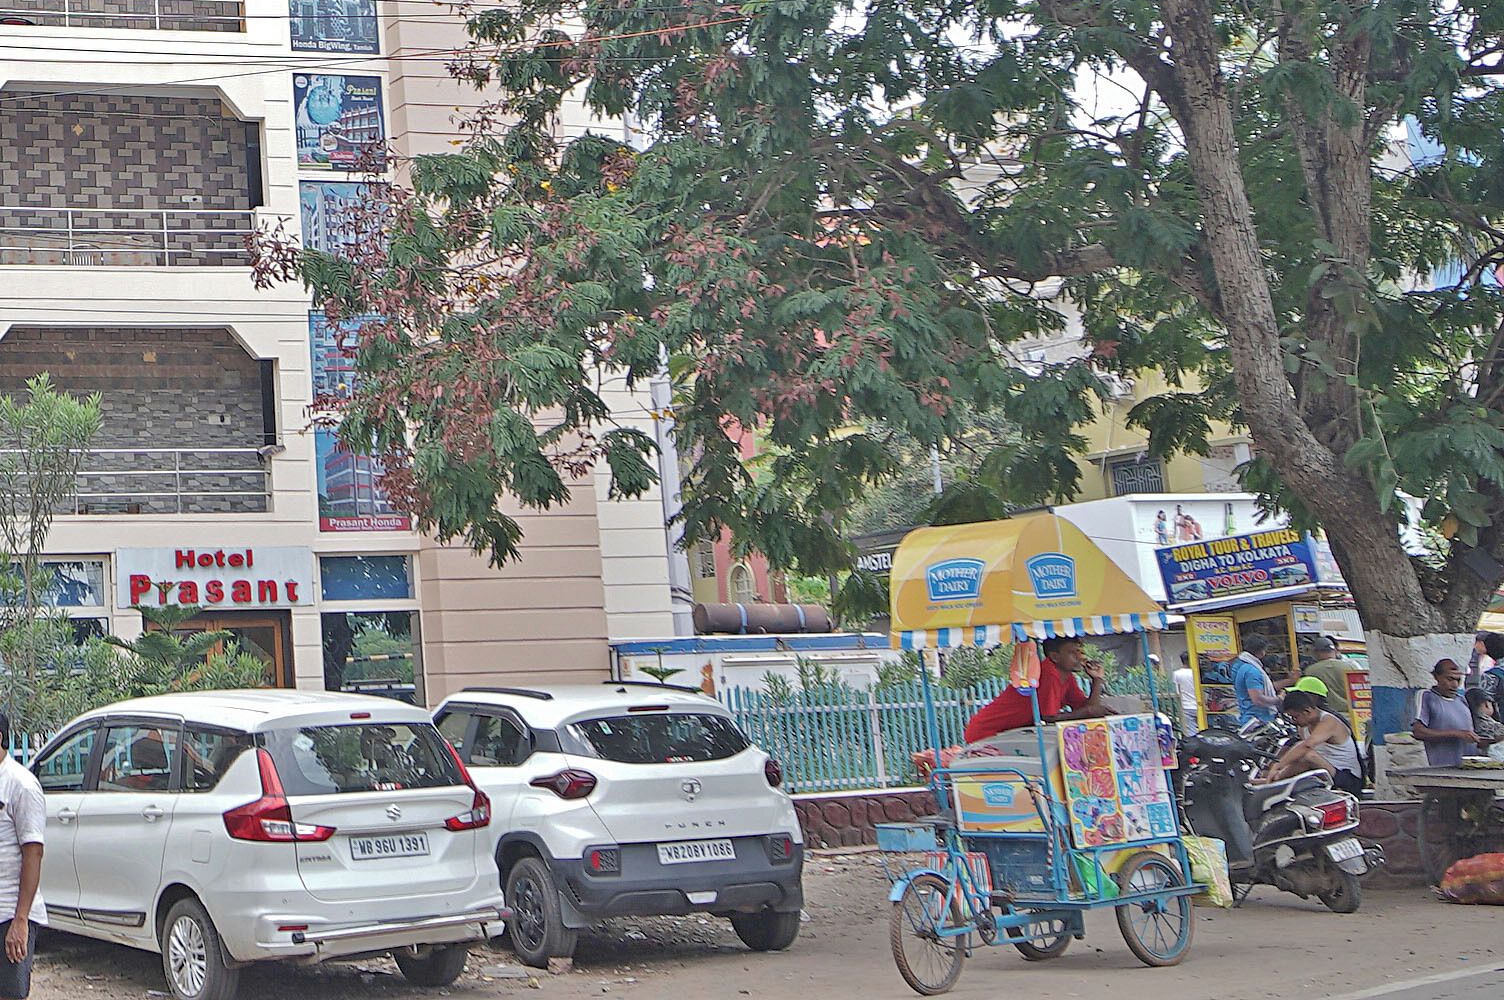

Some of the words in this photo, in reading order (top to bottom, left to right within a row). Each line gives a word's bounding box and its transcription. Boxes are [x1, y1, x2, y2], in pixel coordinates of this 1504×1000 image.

[328, 517, 369, 528] Prasant
[370, 517, 403, 528] Honda
[1171, 542, 1208, 563] ROYAL
[1208, 537, 1238, 556] TOUR
[1251, 529, 1301, 548] TRAVELS
[174, 549, 254, 569] Hotel
[1180, 556, 1218, 573] DIGHA
[1219, 553, 1236, 567] TO
[1236, 545, 1292, 564] KOLKATA
[929, 566, 978, 584] MOTHER
[1033, 564, 1072, 581] MOTHER
[1207, 568, 1268, 589] VOLVO
[129, 573, 299, 605] Prasant
[938, 579, 970, 593] DAIRY
[1040, 577, 1068, 590] DAIRY
[359, 840, 374, 855] WB
